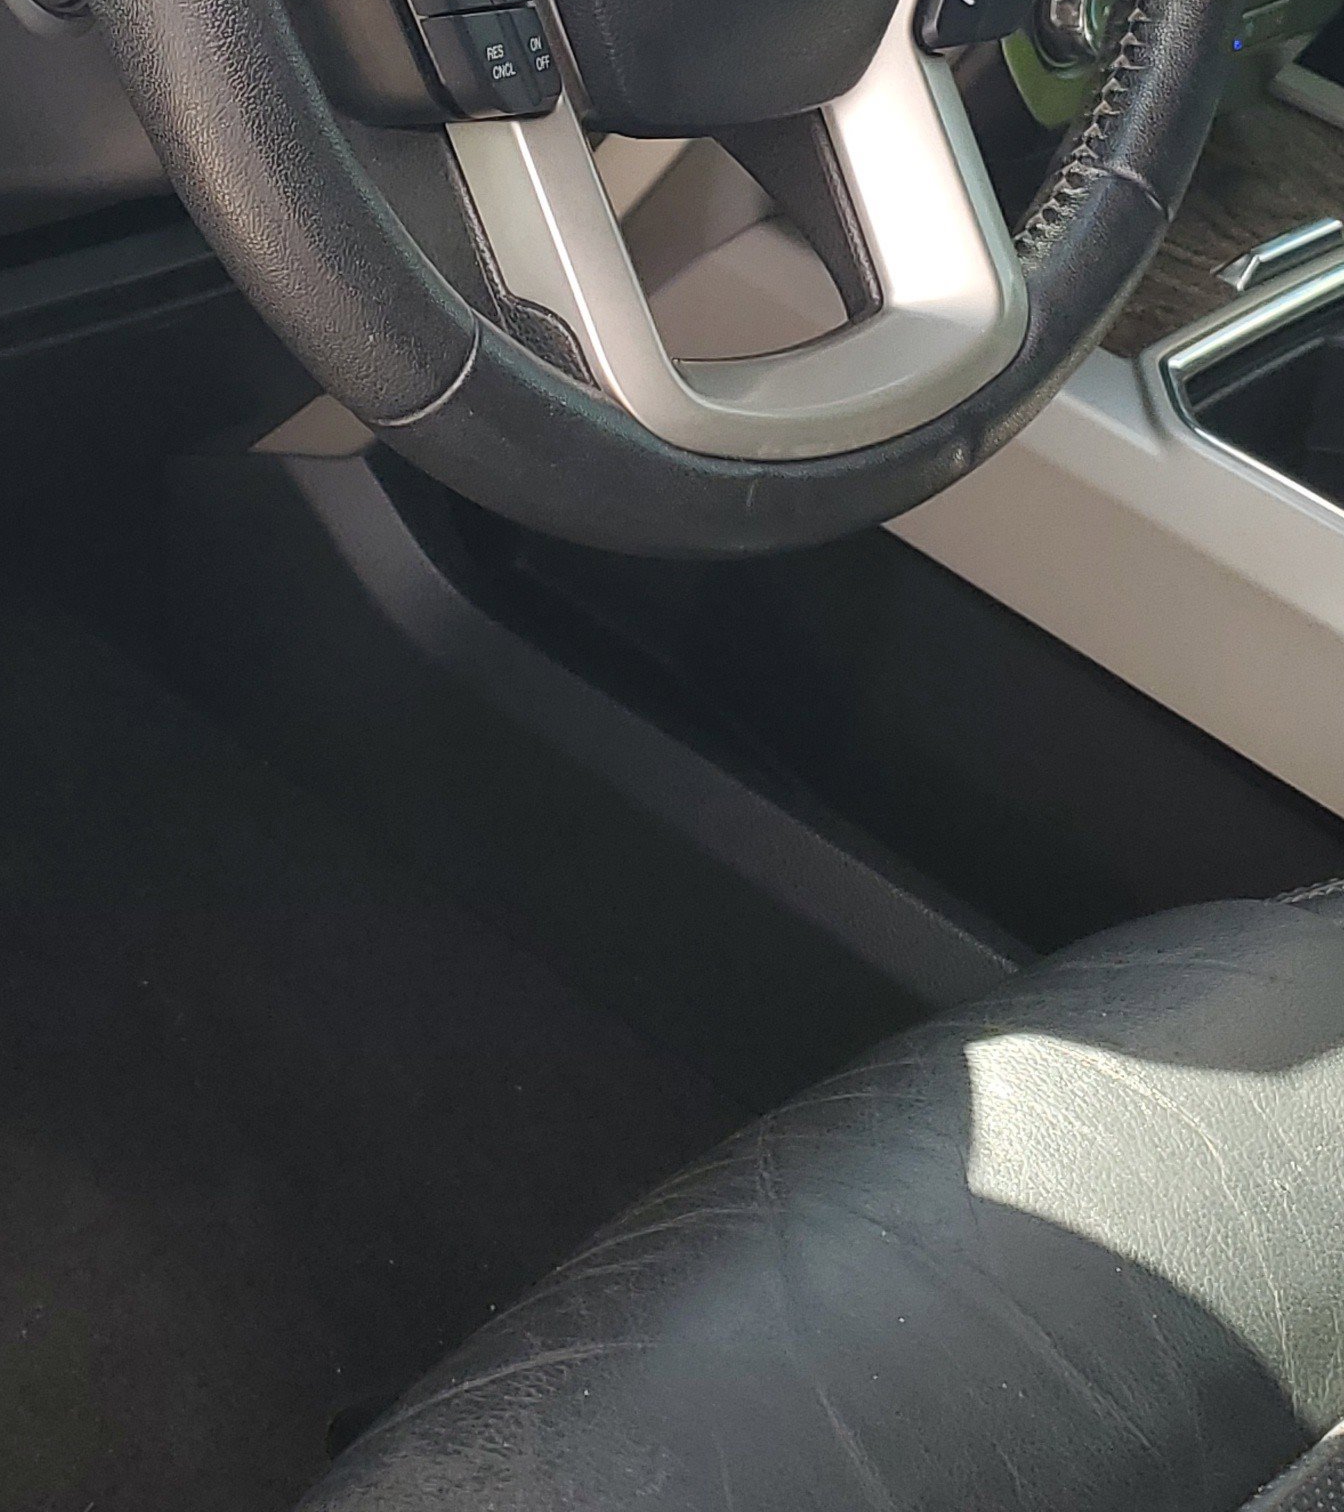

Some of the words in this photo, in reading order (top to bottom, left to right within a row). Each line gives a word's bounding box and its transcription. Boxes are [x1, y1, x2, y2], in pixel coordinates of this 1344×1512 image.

[486, 43, 504, 62] RES
[529, 36, 543, 52] ON
[492, 62, 517, 80] CNCL
[535, 54, 551, 71] OFF
